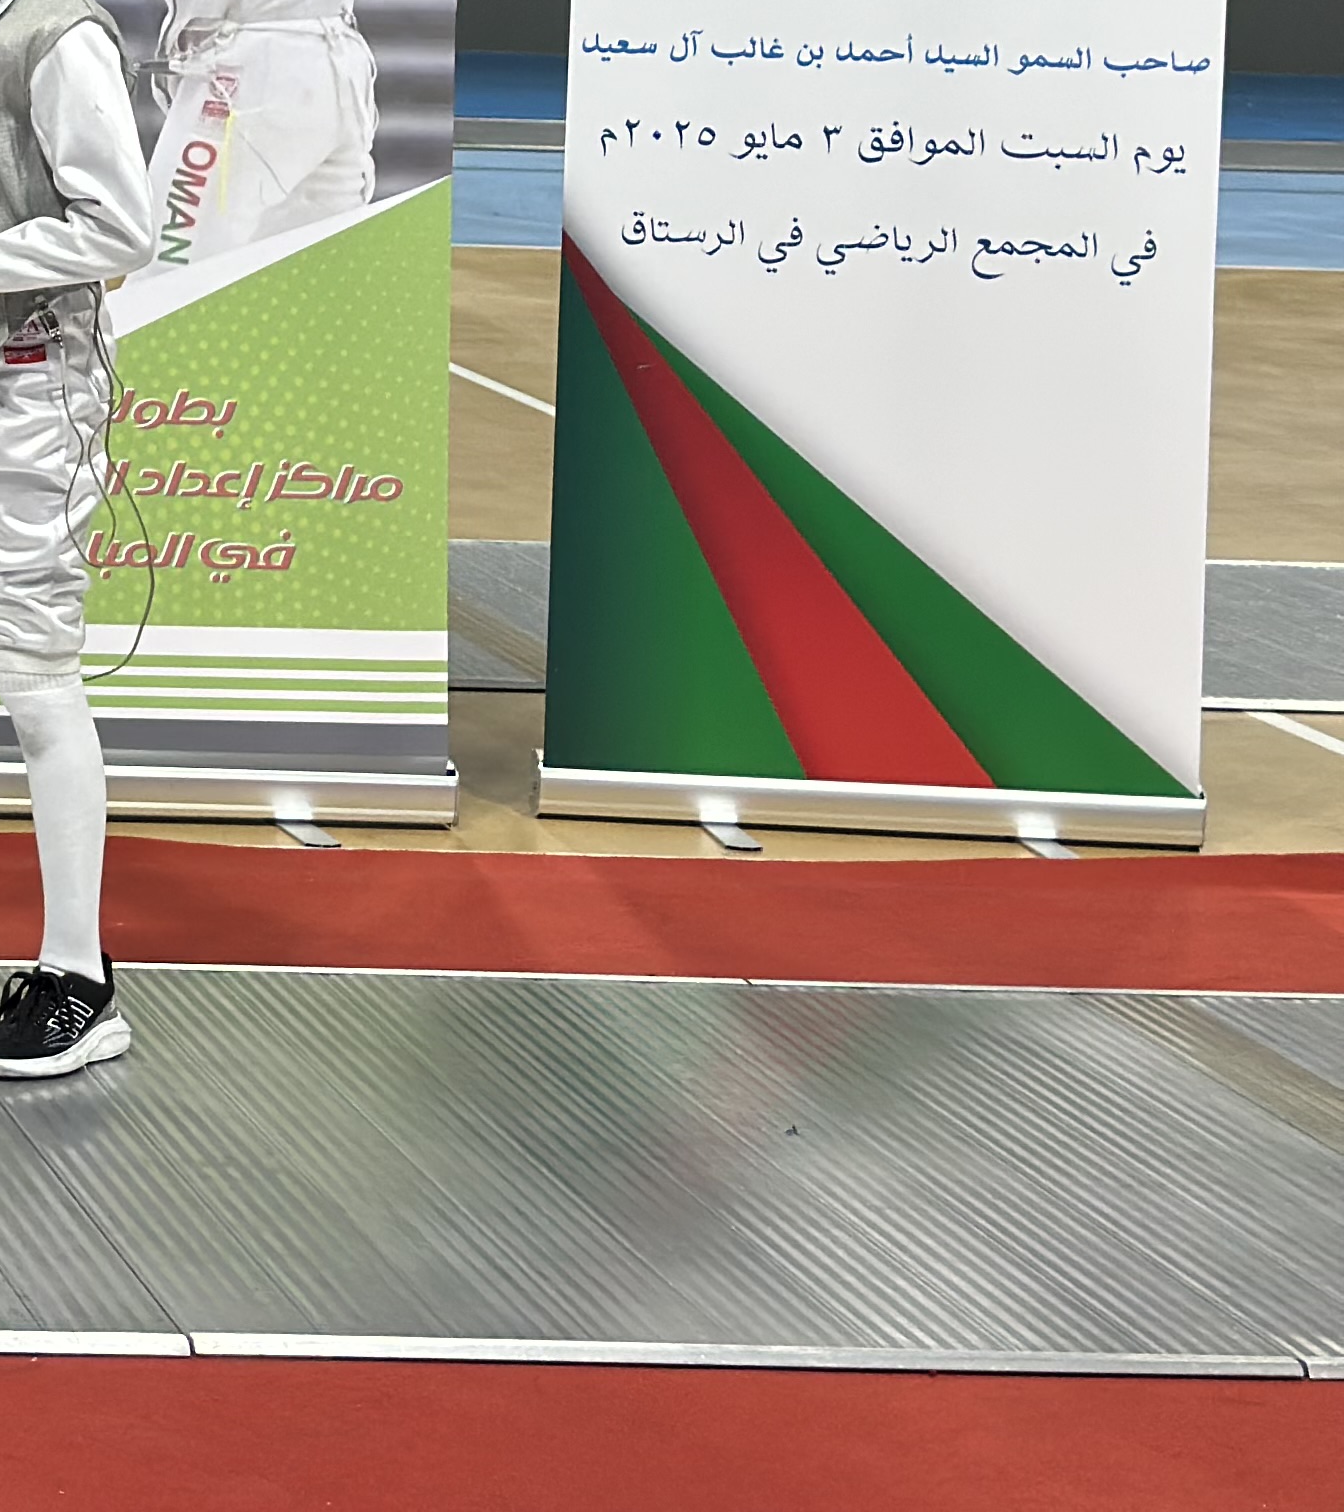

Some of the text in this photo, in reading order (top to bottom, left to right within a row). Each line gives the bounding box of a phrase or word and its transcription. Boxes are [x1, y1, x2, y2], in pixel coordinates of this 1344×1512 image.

[581, 29, 1210, 77] صاحب السمو السيد أحمد بن غالب آل سعيد
[600, 117, 1186, 175] يوم السبت الموافق ٣ مايو ٢٠٢٥م
[158, 141, 217, 265] OMAN
[621, 212, 1157, 286] في المجمع الرياضي في الرستاق
[112, 389, 237, 438] بطول
[135, 462, 264, 509] إعداد
[265, 462, 404, 504] مراكز
[87, 529, 297, 584] في المبا
